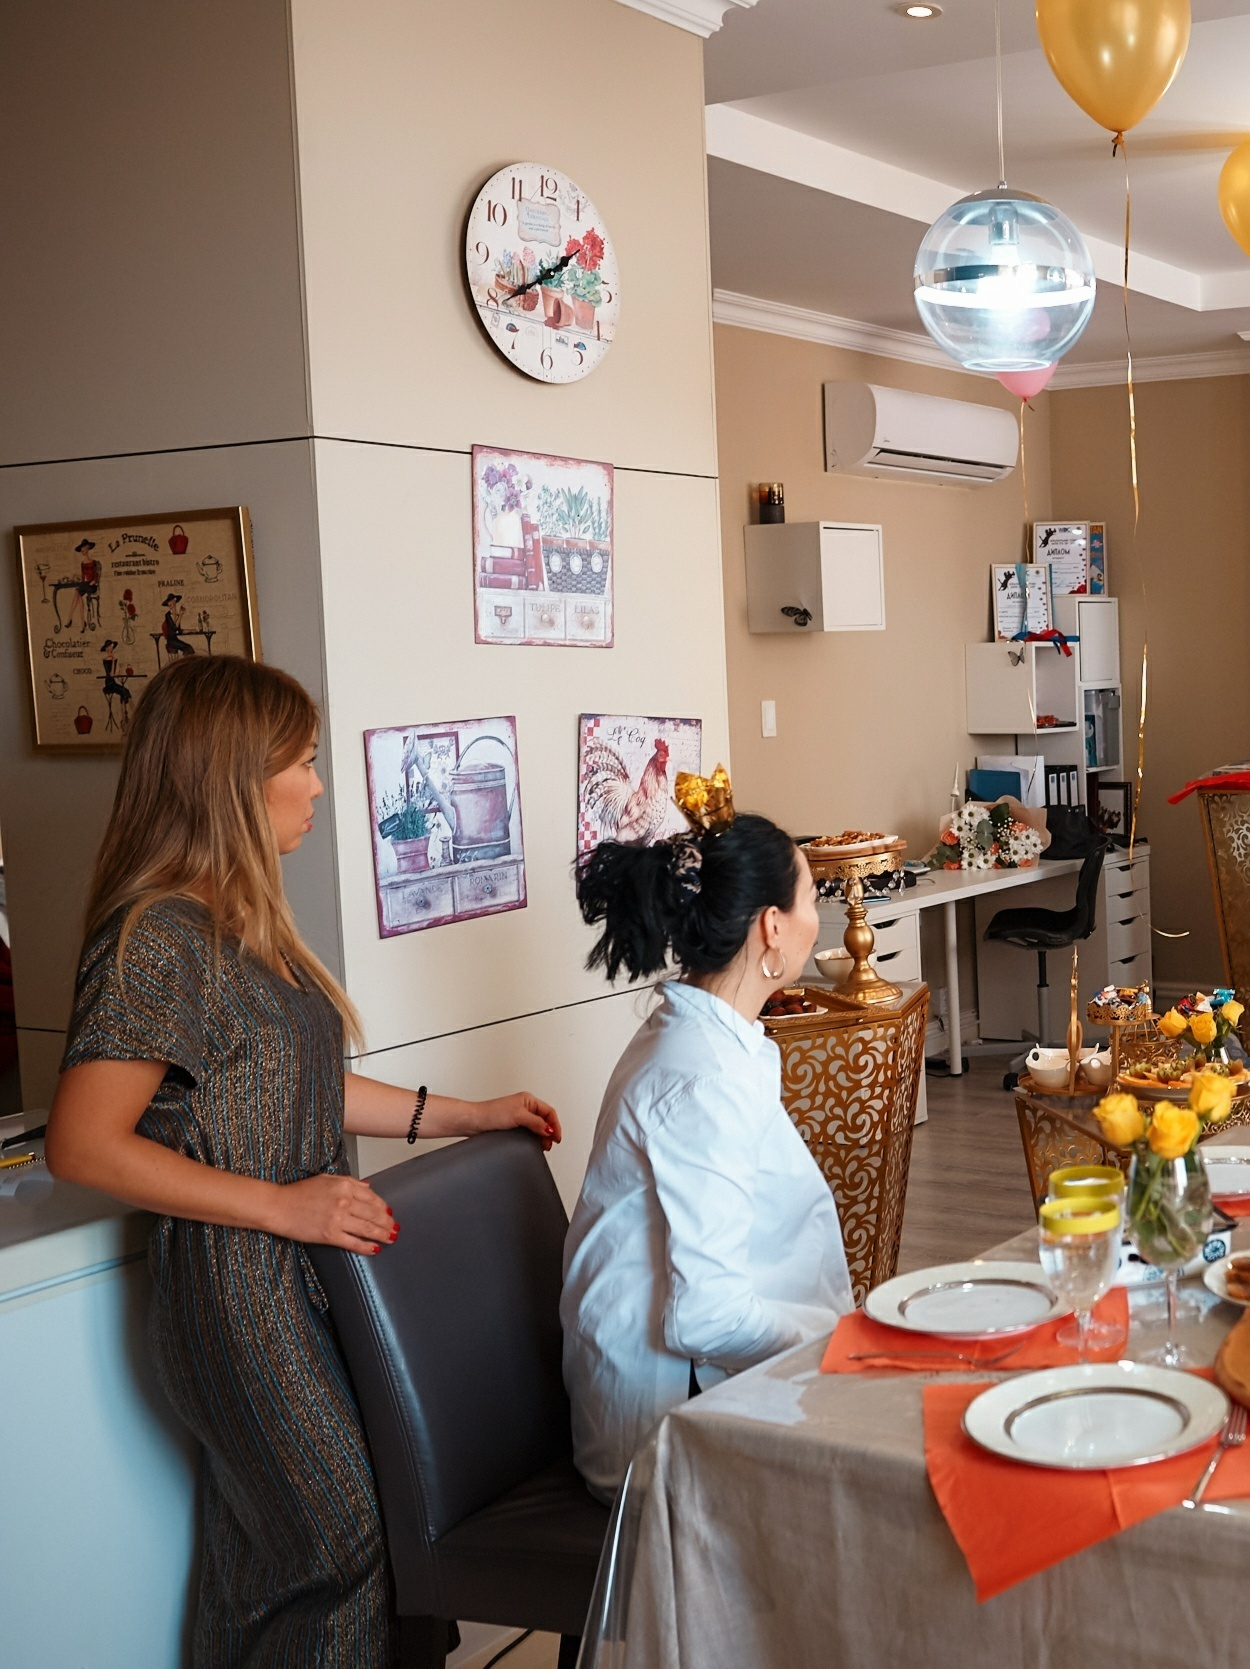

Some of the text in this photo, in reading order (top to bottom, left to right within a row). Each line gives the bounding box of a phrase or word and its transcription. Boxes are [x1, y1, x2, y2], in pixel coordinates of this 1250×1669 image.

[509, 177, 523, 202] 11
[540, 174, 558, 202] 12
[486, 199, 508, 227] 10
[575, 199, 581, 222] 1
[475, 241, 490, 265] 9
[486, 287, 499, 309] 8
[540, 347, 554, 370] 6
[108, 533, 160, 553] La Prunelle
[1046, 548, 1071, 557] ДИПЛОМ
[111, 560, 142, 568] restaurant
[157, 578, 185, 588] PRALINE
[574, 602, 600, 615] LILAS
[43, 637, 91, 650] Chocolatier
[626, 726, 646, 748] Coq
[469, 871, 508, 887] ROMARIN
